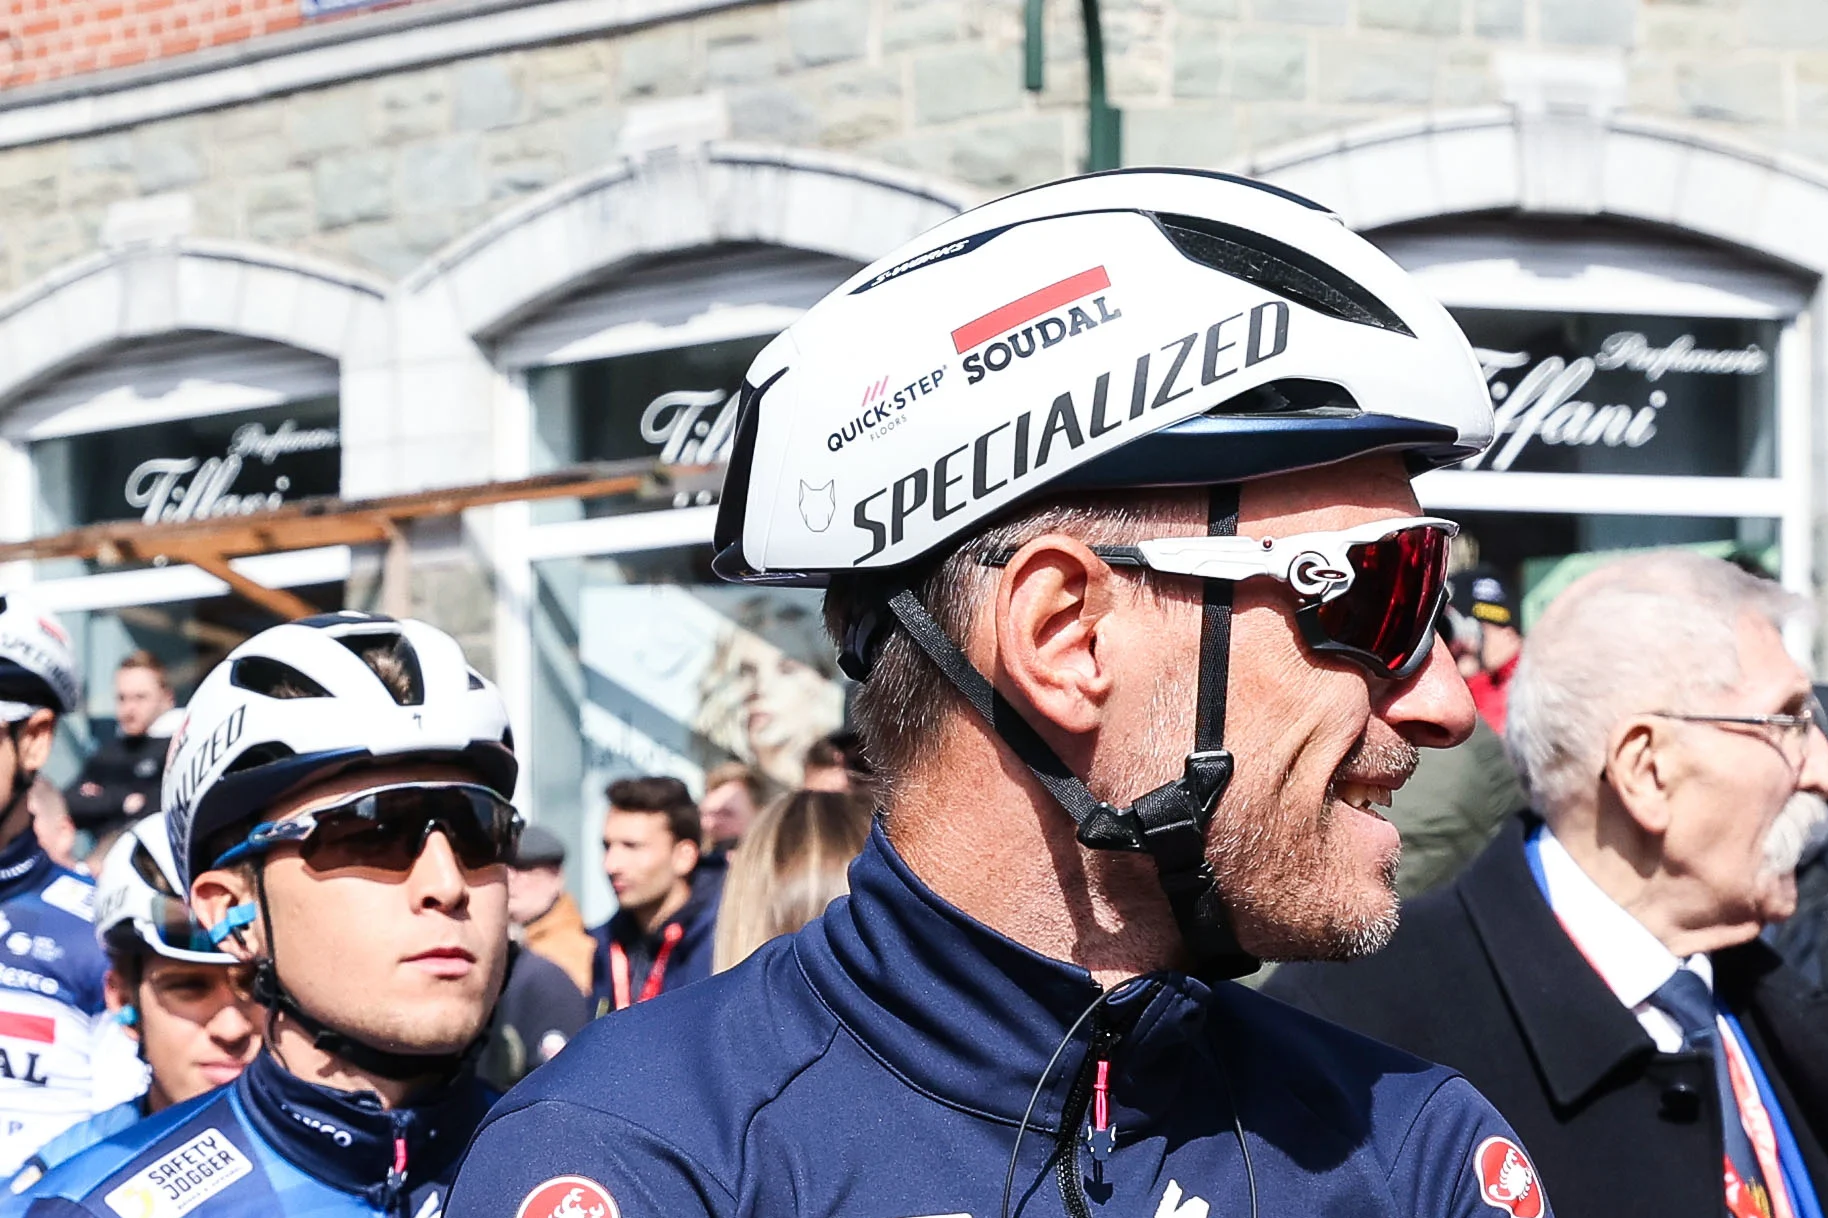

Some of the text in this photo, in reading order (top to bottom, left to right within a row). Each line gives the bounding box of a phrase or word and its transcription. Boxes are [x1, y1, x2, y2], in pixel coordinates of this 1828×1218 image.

[962, 296, 1122, 385] SOUDAL
[853, 301, 1290, 566] SPECIALIZED
[869, 413, 908, 443] FLOORS
[148, 1134, 219, 1187] SAFETY
[162, 1149, 236, 1203] JOGGER
